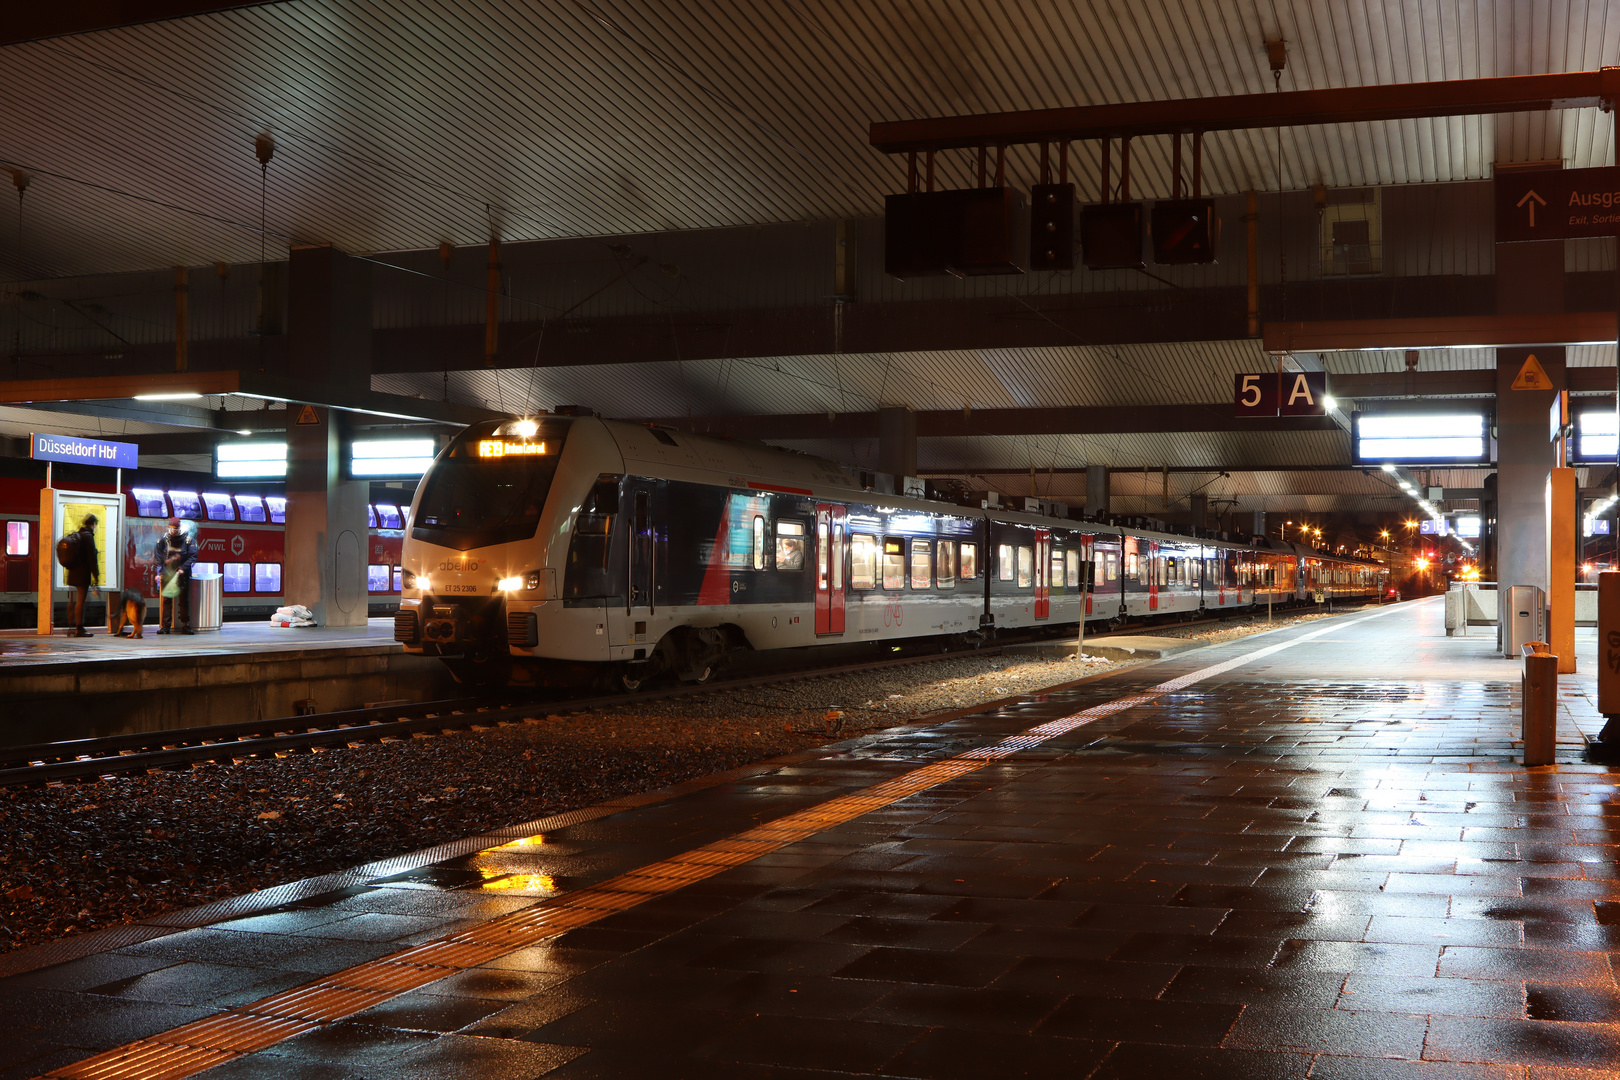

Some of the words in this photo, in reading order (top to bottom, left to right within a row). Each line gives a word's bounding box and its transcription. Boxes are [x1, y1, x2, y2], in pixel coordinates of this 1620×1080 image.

[1568, 215, 1589, 226] Exit,
[1240, 374, 1262, 407] 5
[1287, 373, 1315, 406] A
[39, 438, 97, 458] Düsseldorf
[98, 444, 118, 460] Hbf
[479, 440, 503, 457] RE19
[1421, 520, 1430, 532] 5
[1599, 519, 1608, 532] 4
[208, 543, 226, 551] NWL
[439, 558, 479, 571] abellio
[445, 584, 452, 592] ET
[453, 584, 461, 592] 25
[461, 584, 477, 592] 2306
